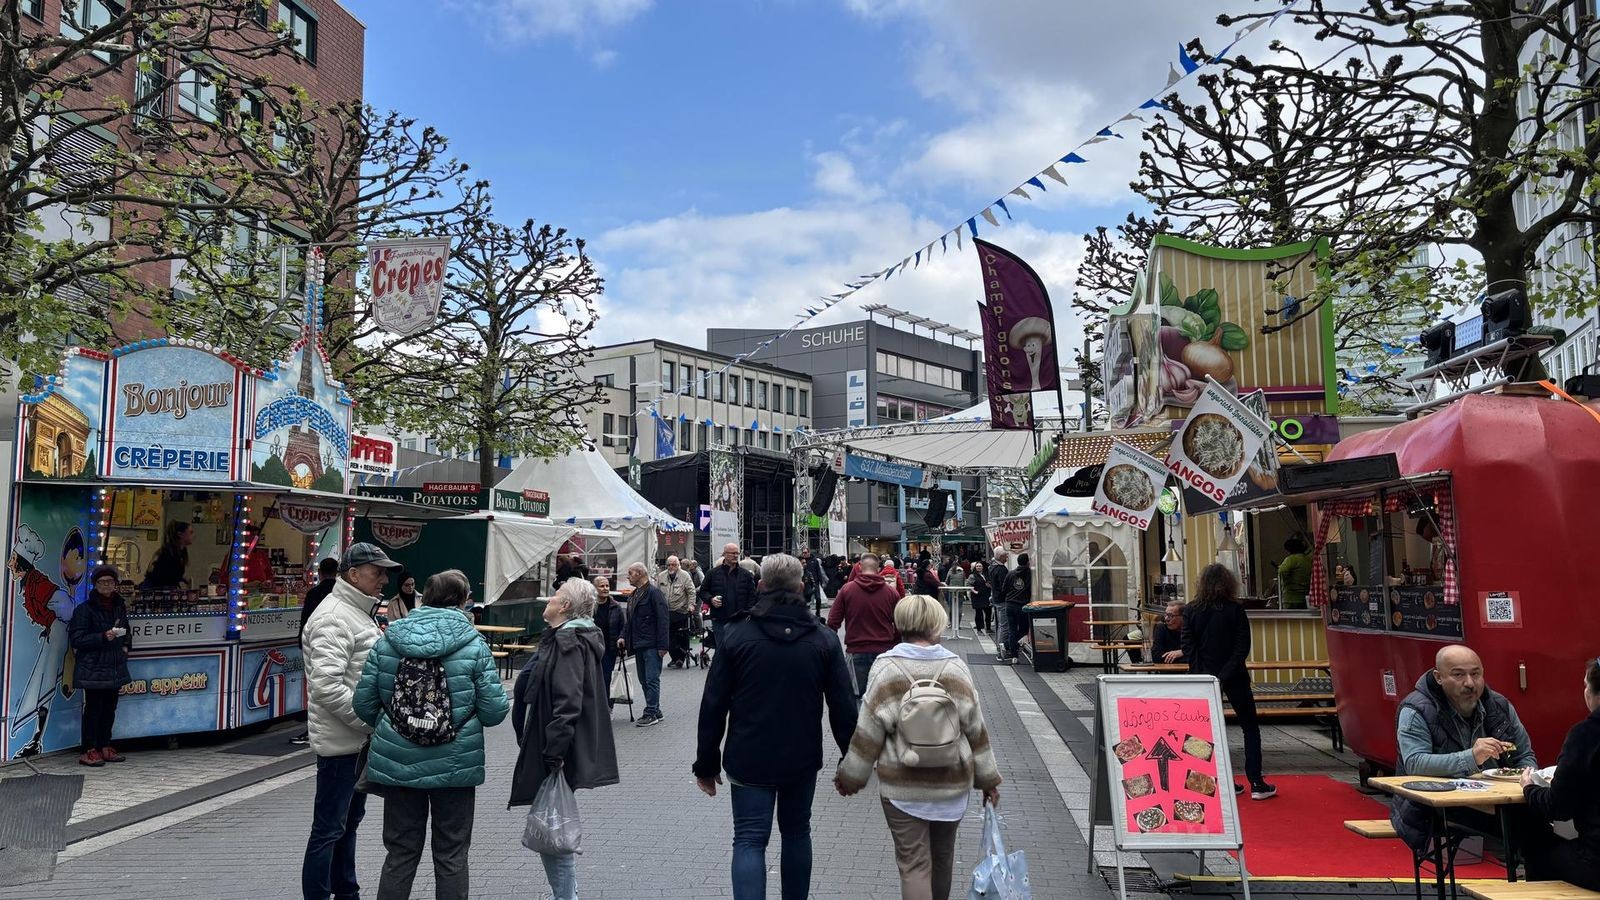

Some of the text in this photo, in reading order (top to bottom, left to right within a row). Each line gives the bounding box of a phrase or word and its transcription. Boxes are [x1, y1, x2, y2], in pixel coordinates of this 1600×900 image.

[373, 257, 443, 297] Crêpes
[985, 254, 1013, 390] Champignons
[802, 326, 865, 348] SCHUHE
[123, 380, 234, 419] Bonjour
[114, 443, 230, 472] CRÊPERIE
[428, 484, 476, 492] HAGEBAUM'S
[1164, 454, 1226, 502] LÁNGOS
[413, 492, 478, 506] POTATOES
[496, 493, 546, 513] BAKED POTATOES
[288, 505, 332, 522] Crêpes
[1092, 499, 1148, 529] LÁNGOS
[1005, 520, 1026, 530] XXL
[132, 622, 203, 636] RÊPERIE
